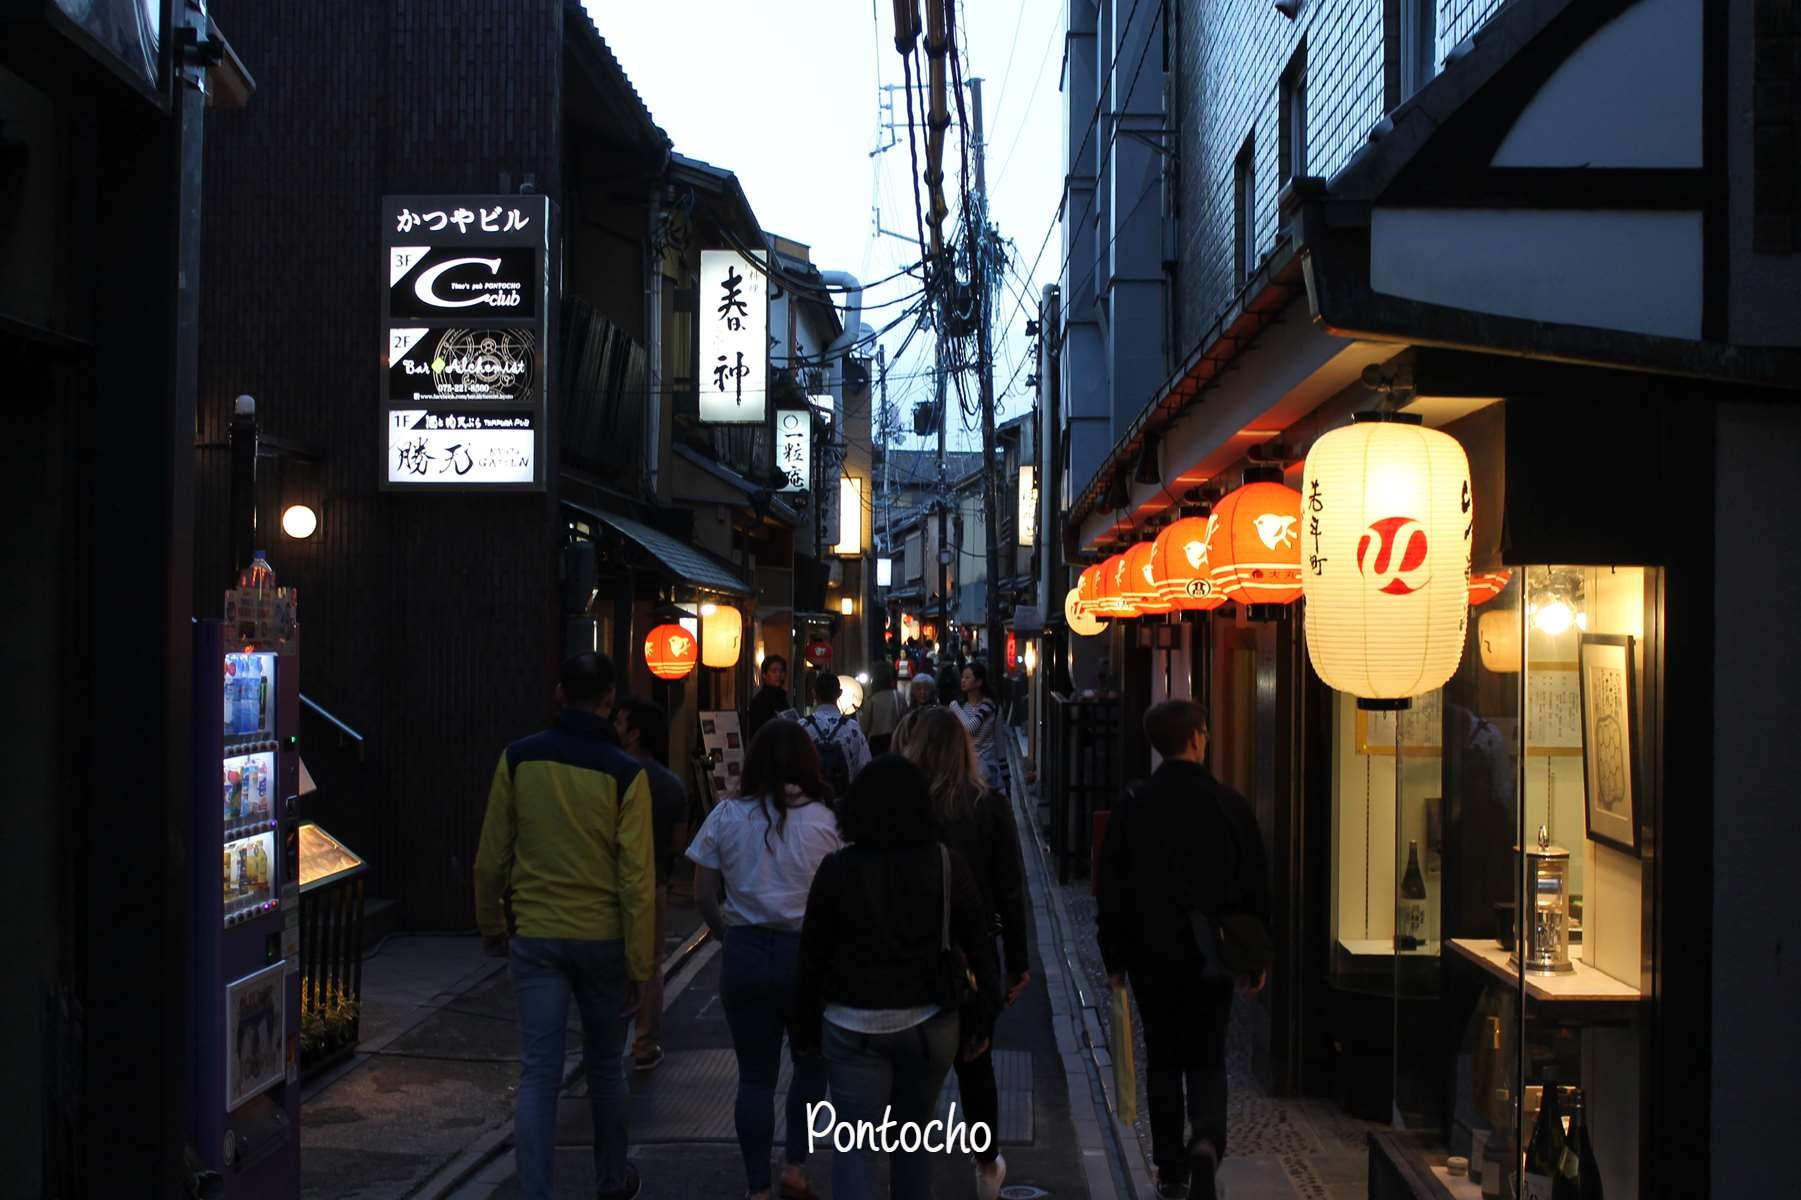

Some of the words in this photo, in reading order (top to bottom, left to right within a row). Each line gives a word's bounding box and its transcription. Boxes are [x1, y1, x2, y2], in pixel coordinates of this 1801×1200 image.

[396, 207, 530, 234] かつやビル
[395, 254, 412, 267] 3F
[484, 282, 521, 290] PONTOCHO
[488, 290, 521, 307] club
[394, 336, 411, 349] 2F
[402, 359, 431, 375] Bar
[445, 356, 525, 375] Alchemist
[395, 415, 411, 428] 1F
